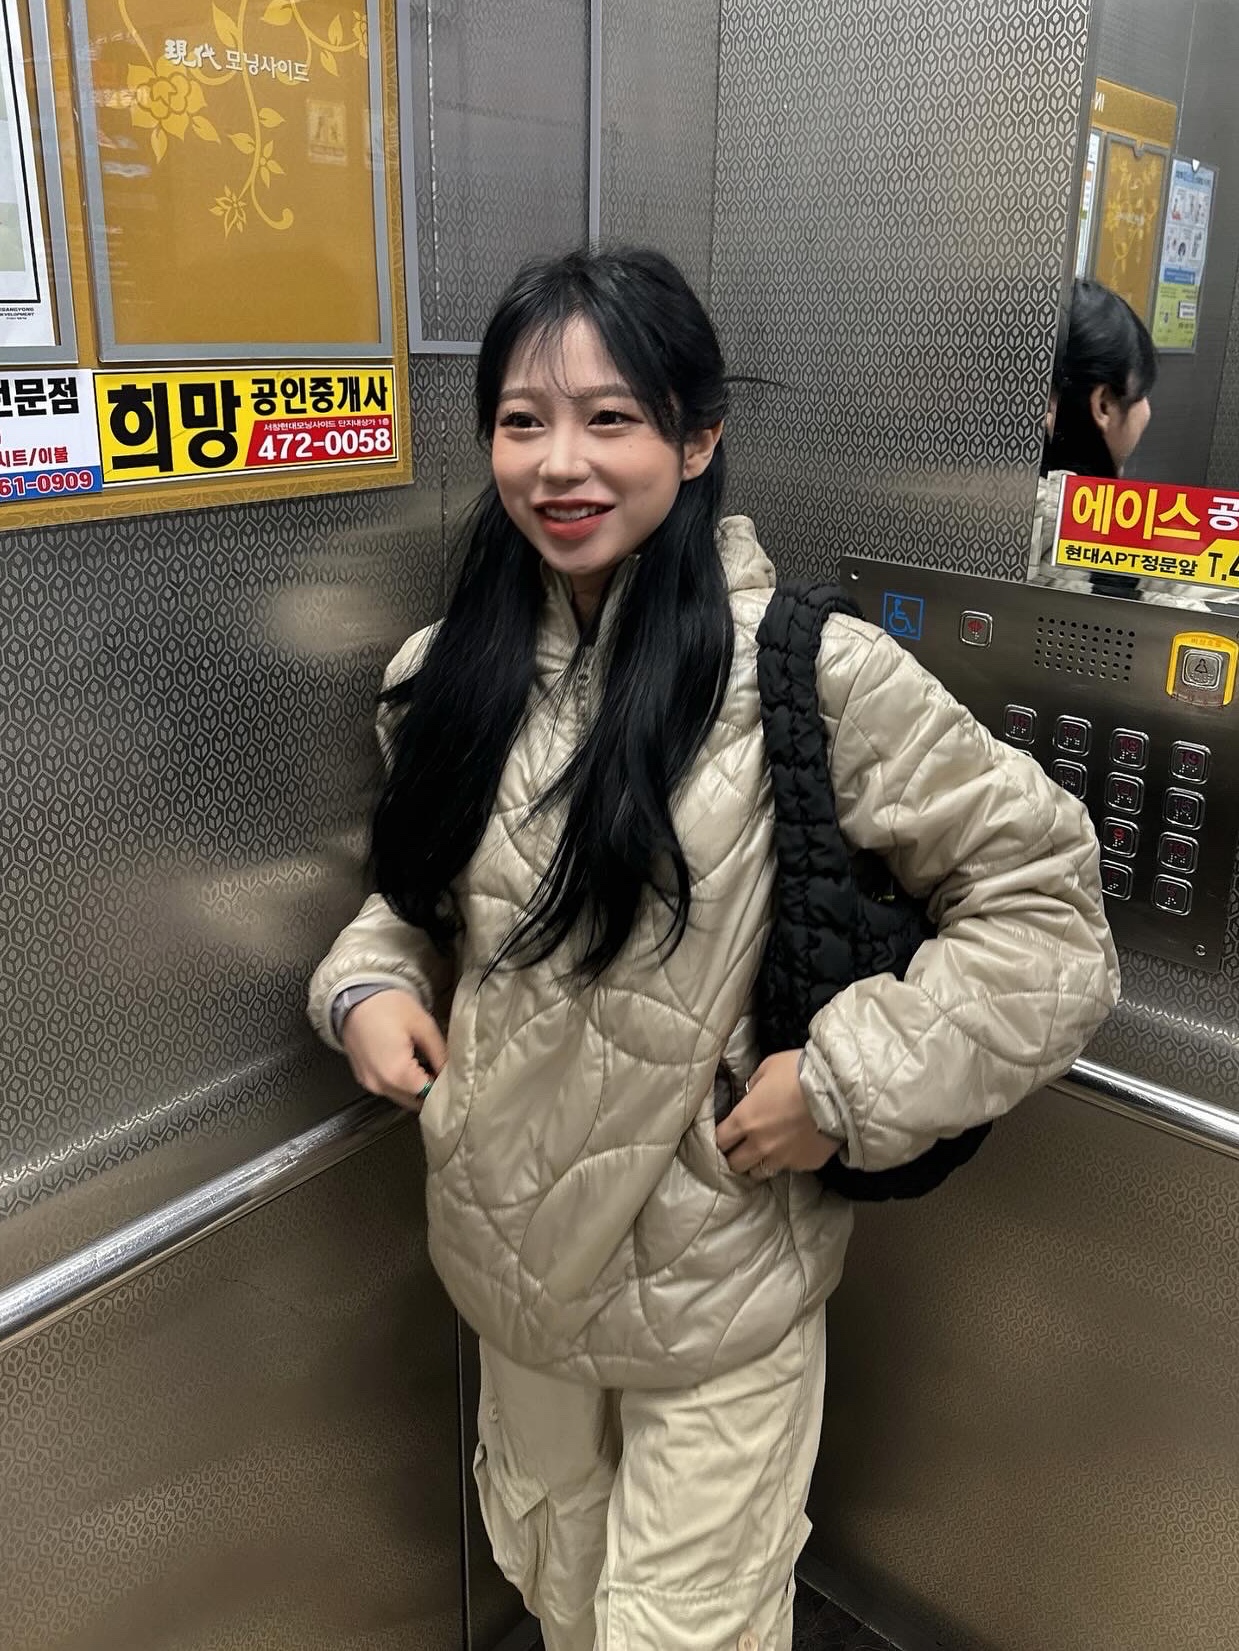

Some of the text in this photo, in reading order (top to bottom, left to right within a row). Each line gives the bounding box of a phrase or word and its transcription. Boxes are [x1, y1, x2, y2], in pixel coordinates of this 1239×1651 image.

[225, 49, 310, 82] 모닝사이드
[107, 375, 388, 472] 희망 공인중개사
[257, 427, 391, 460] 472-0058
[0, 470, 93, 497] 61-0909
[1072, 484, 1201, 540] 에이스
[1065, 544, 1198, 577] 현대APT정문앞
